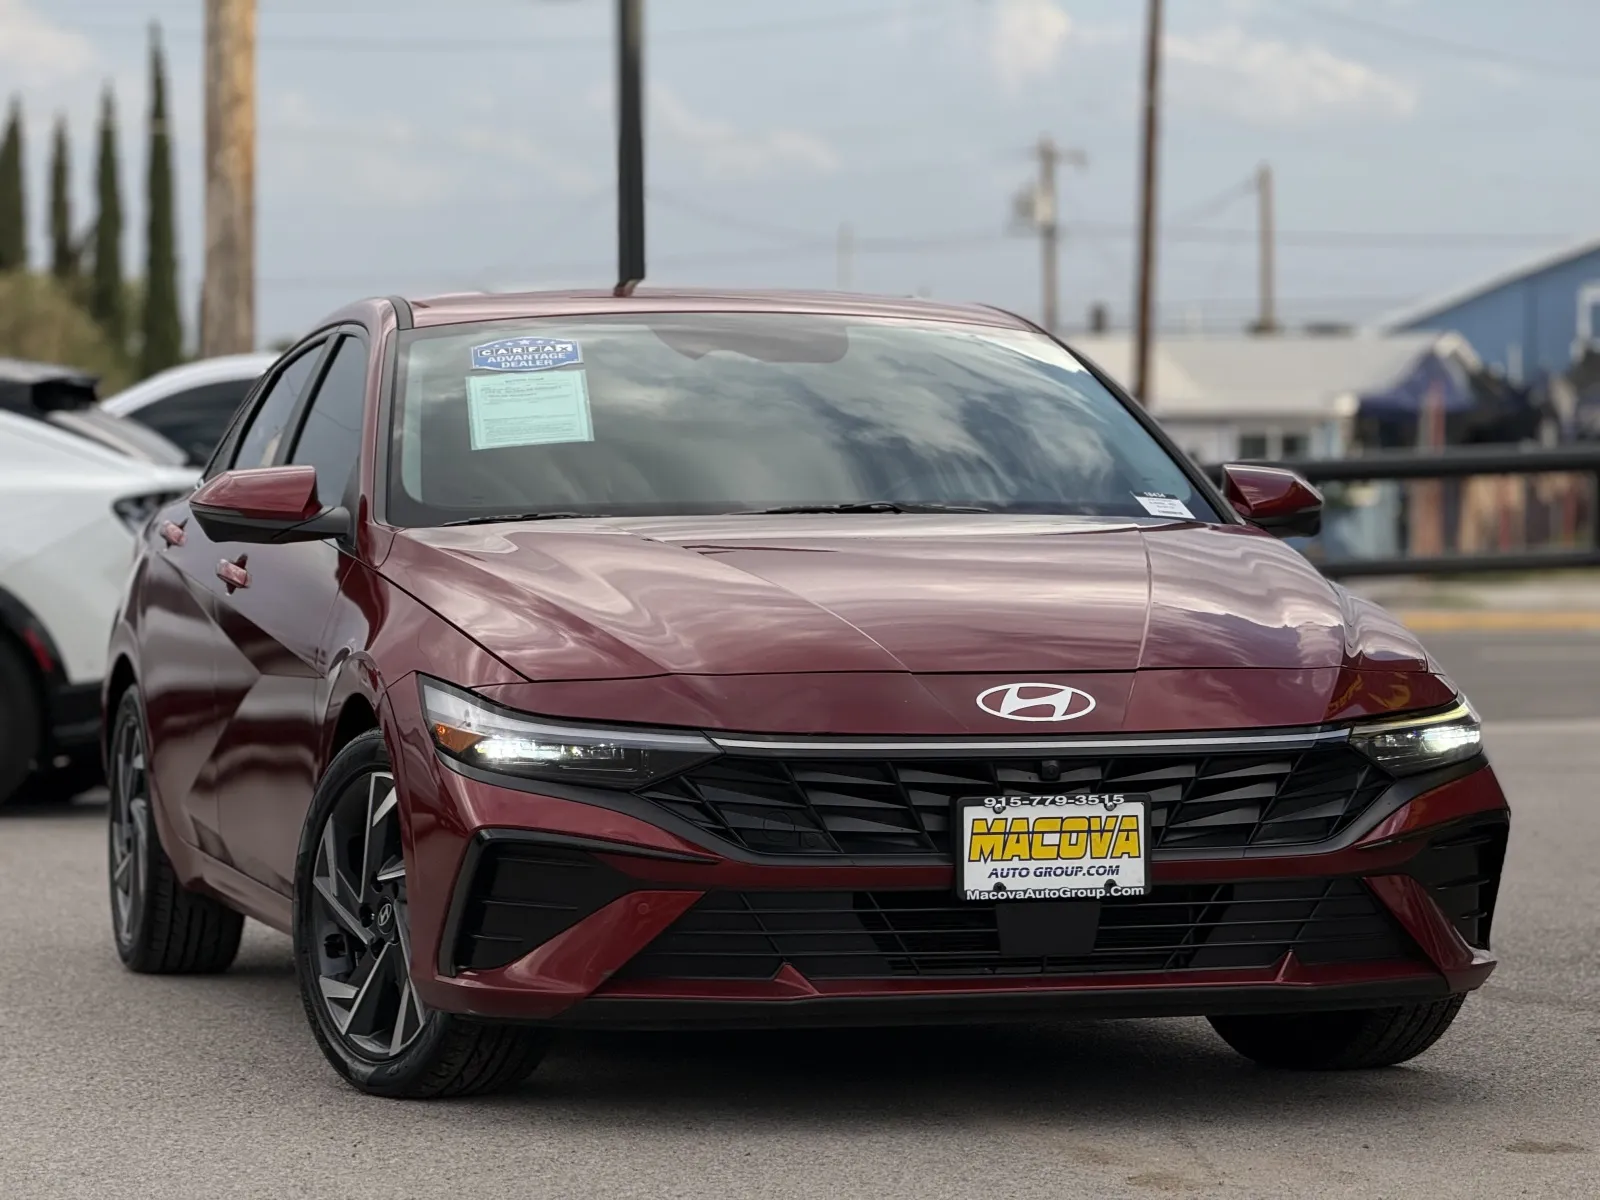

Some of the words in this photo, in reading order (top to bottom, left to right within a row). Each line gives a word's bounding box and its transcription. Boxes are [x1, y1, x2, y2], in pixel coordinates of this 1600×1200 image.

[479, 344, 572, 357] CARFAX
[487, 352, 567, 363] ADVANTAGE
[501, 359, 553, 368] DEALER
[984, 794, 1125, 808] 915-779-3515
[968, 815, 1141, 864] MACOVA
[988, 867, 1031, 879] AUTO
[1033, 865, 1120, 877] GROUP.COM
[966, 886, 1145, 901] MacovaAutoGroup.Com
